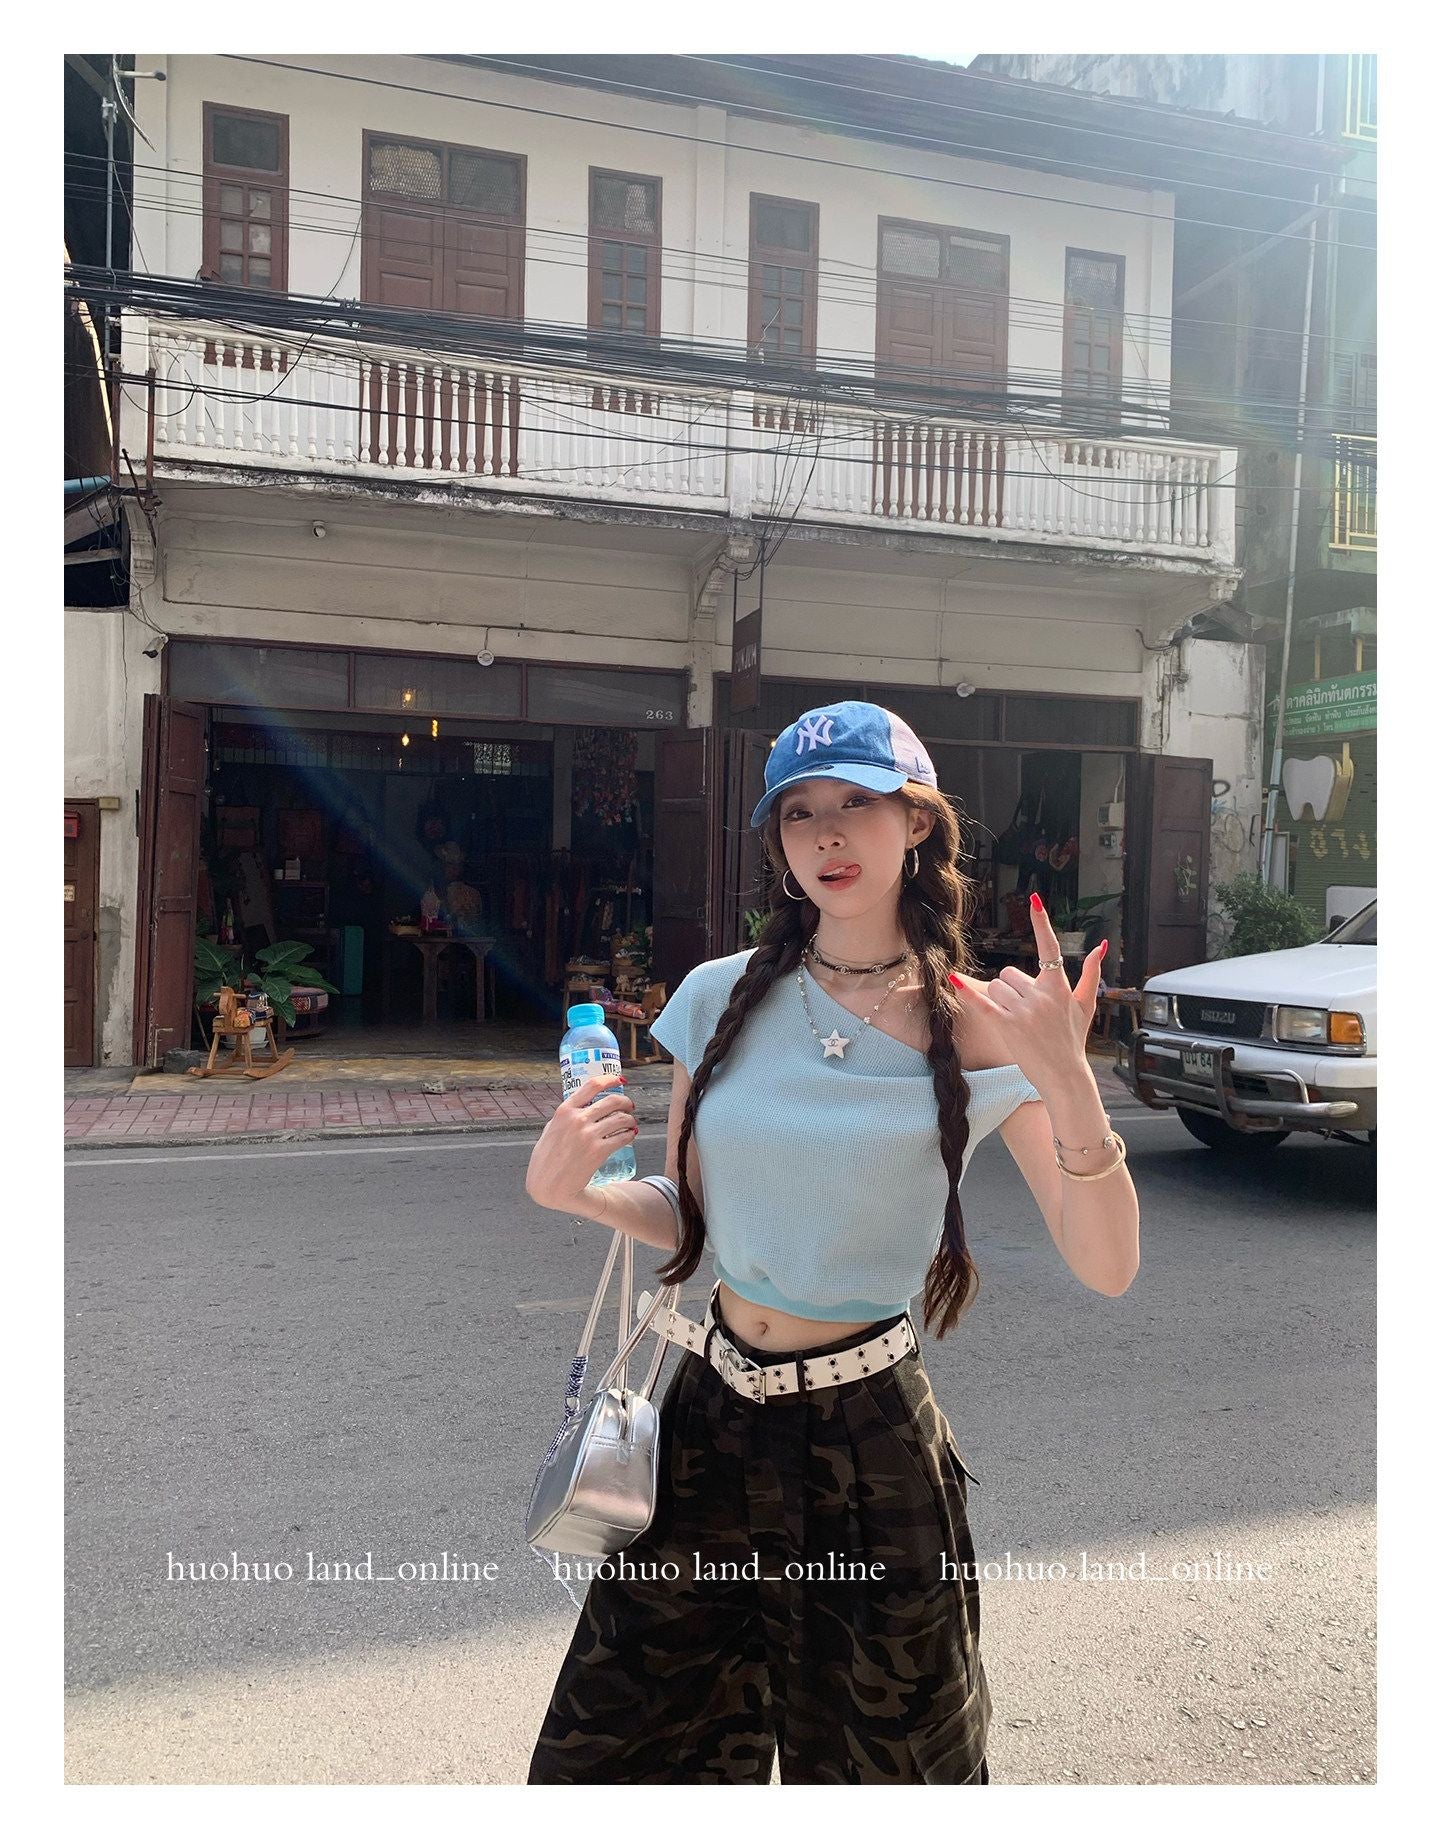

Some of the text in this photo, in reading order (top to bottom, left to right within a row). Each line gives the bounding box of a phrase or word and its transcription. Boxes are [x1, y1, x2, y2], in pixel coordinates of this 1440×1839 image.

[645, 709, 674, 721] 263
[795, 714, 835, 756] NY
[1200, 1009, 1236, 1024] ISUZU
